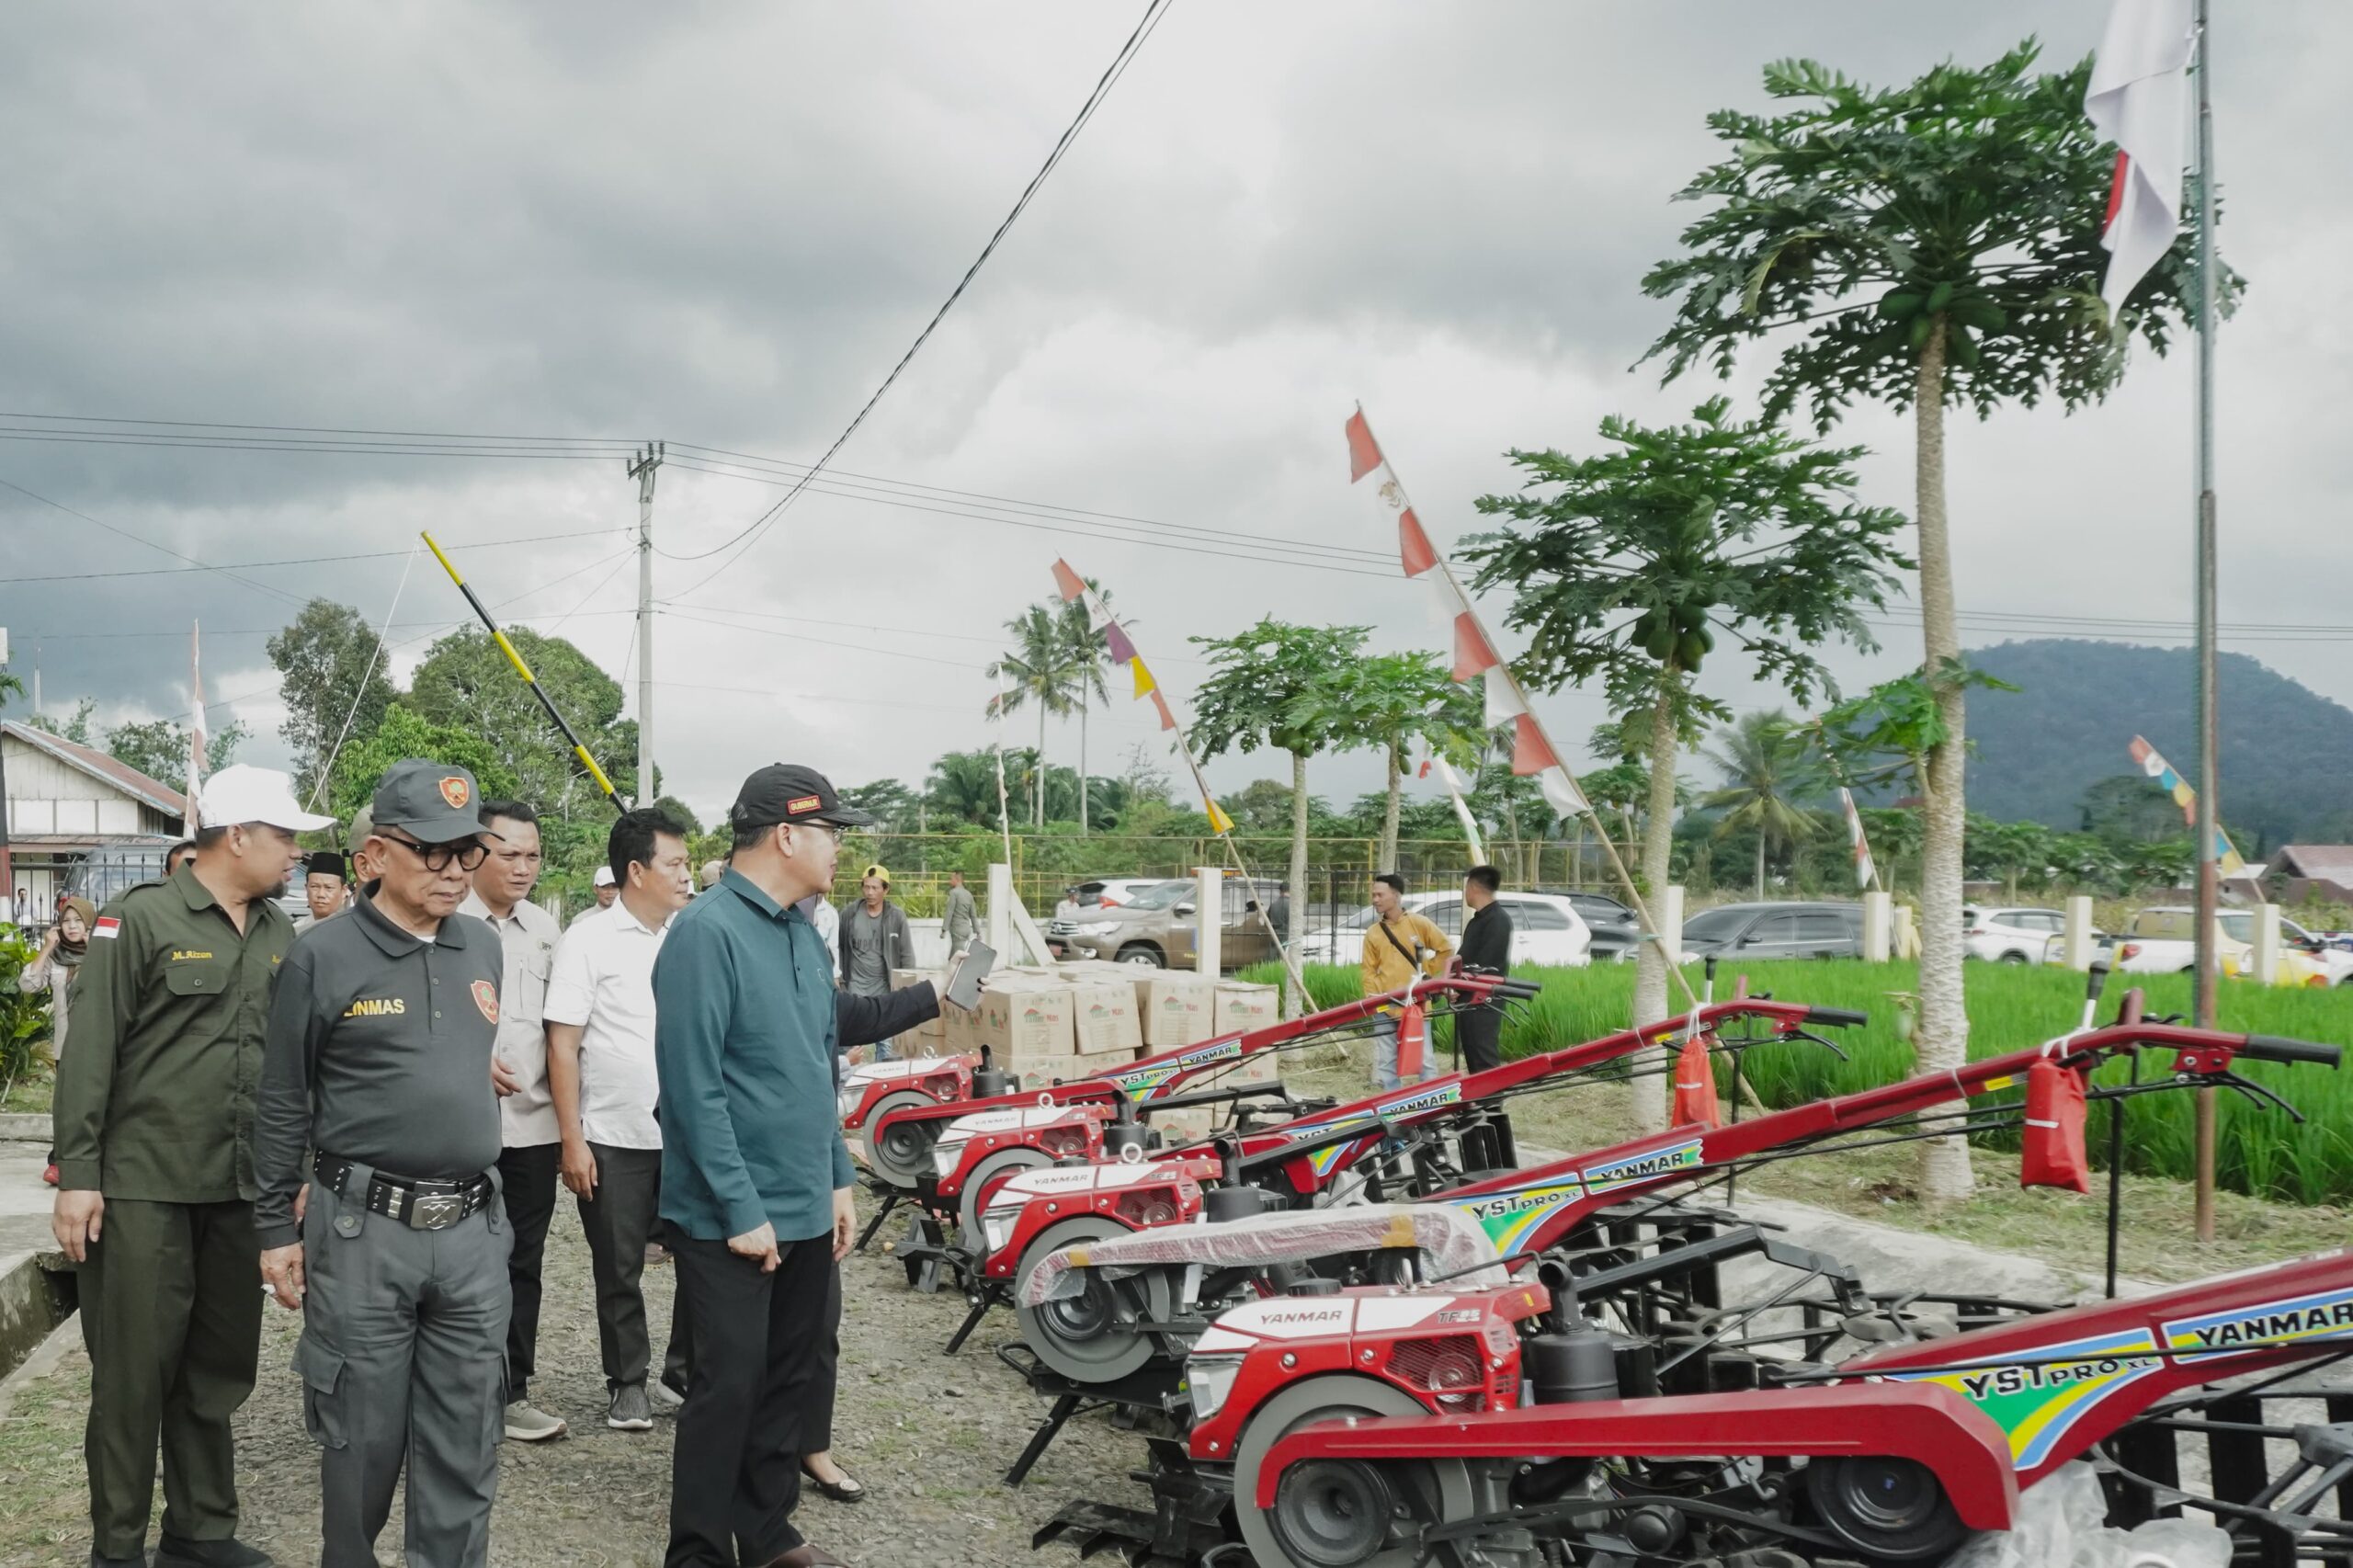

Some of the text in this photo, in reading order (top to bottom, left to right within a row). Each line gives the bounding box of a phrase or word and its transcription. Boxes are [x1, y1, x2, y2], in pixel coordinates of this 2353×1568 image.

[1189, 1046, 1233, 1064] YANMAR
[1389, 1093, 1449, 1116] YANMAR
[1602, 1153, 1684, 1179] YANMAR
[1034, 1175, 1088, 1186] YANMAR
[1261, 1311, 1342, 1324] YANMAR
[2195, 1303, 2353, 1346] YANMAR
